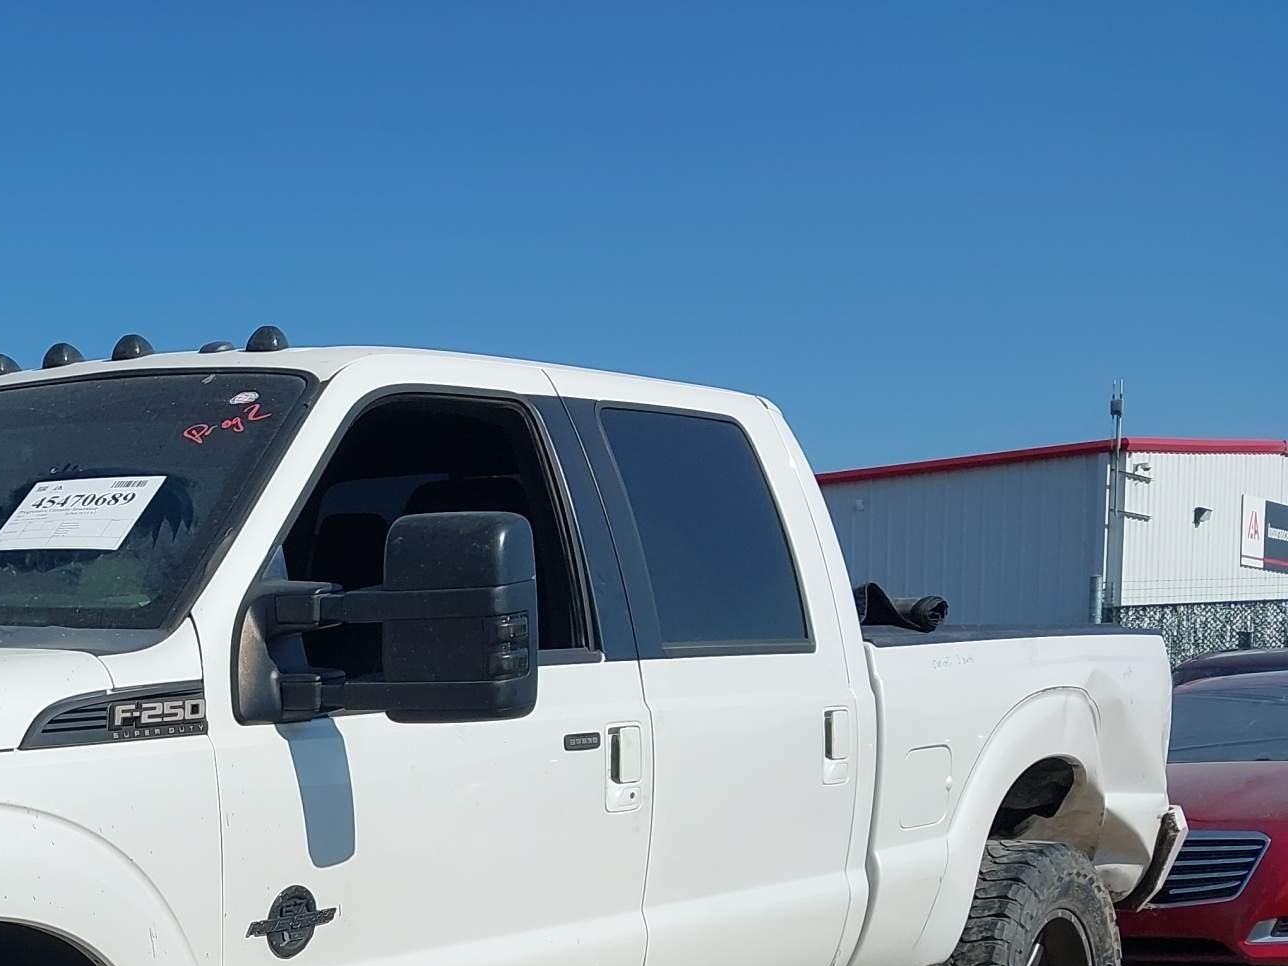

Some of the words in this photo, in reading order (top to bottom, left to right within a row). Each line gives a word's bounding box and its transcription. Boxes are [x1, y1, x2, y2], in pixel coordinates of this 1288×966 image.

[31, 491, 137, 509] 45470689
[113, 699, 205, 726] F-250
[112, 728, 162, 740] SUPER
[167, 724, 205, 735] DUTY
